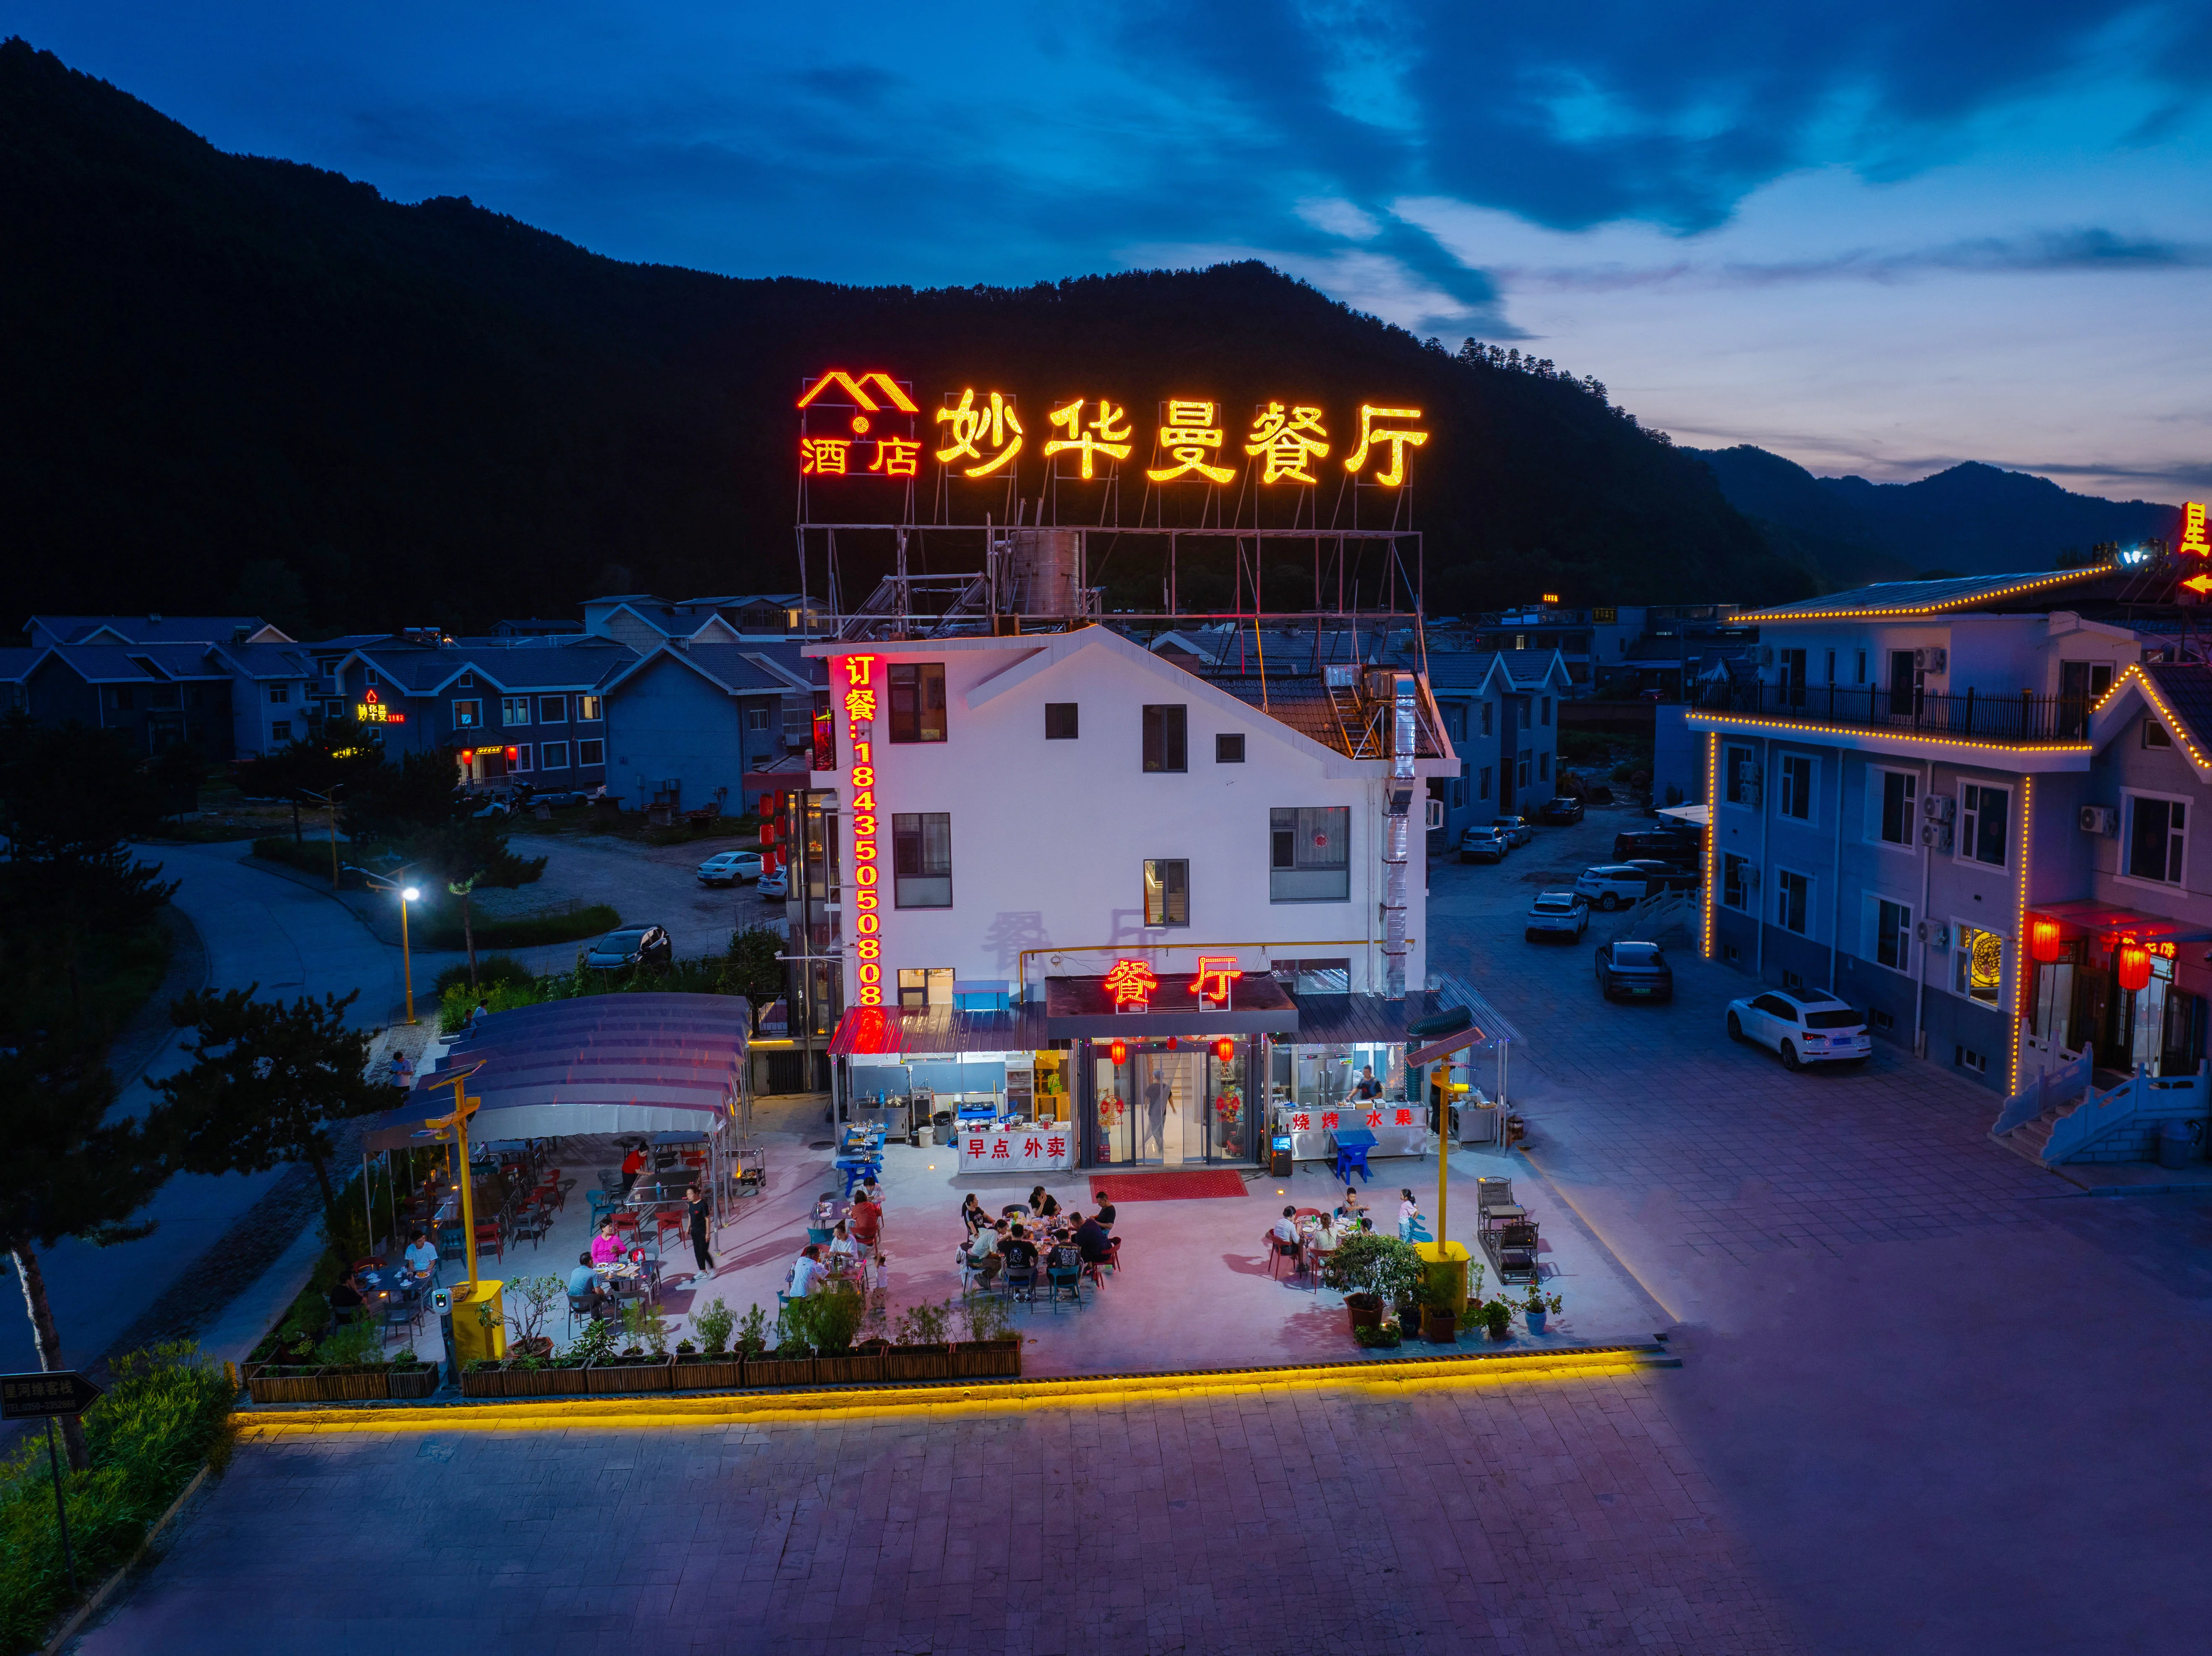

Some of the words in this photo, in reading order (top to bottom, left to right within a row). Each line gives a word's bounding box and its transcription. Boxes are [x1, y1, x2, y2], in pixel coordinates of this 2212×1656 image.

[801, 436, 921, 476] 酒店
[936, 388, 1428, 486] 妙华曼餐厅
[2181, 502, 2210, 557] 星
[1105, 956, 1242, 1003] 餐厅
[1292, 1112, 1339, 1130] 烧烤
[1366, 1109, 1412, 1128] 水果
[968, 1138, 1009, 1159] 早点
[1024, 1137, 1065, 1158] 外卖
[5, 1380, 74, 1398] 星河缘客栈
